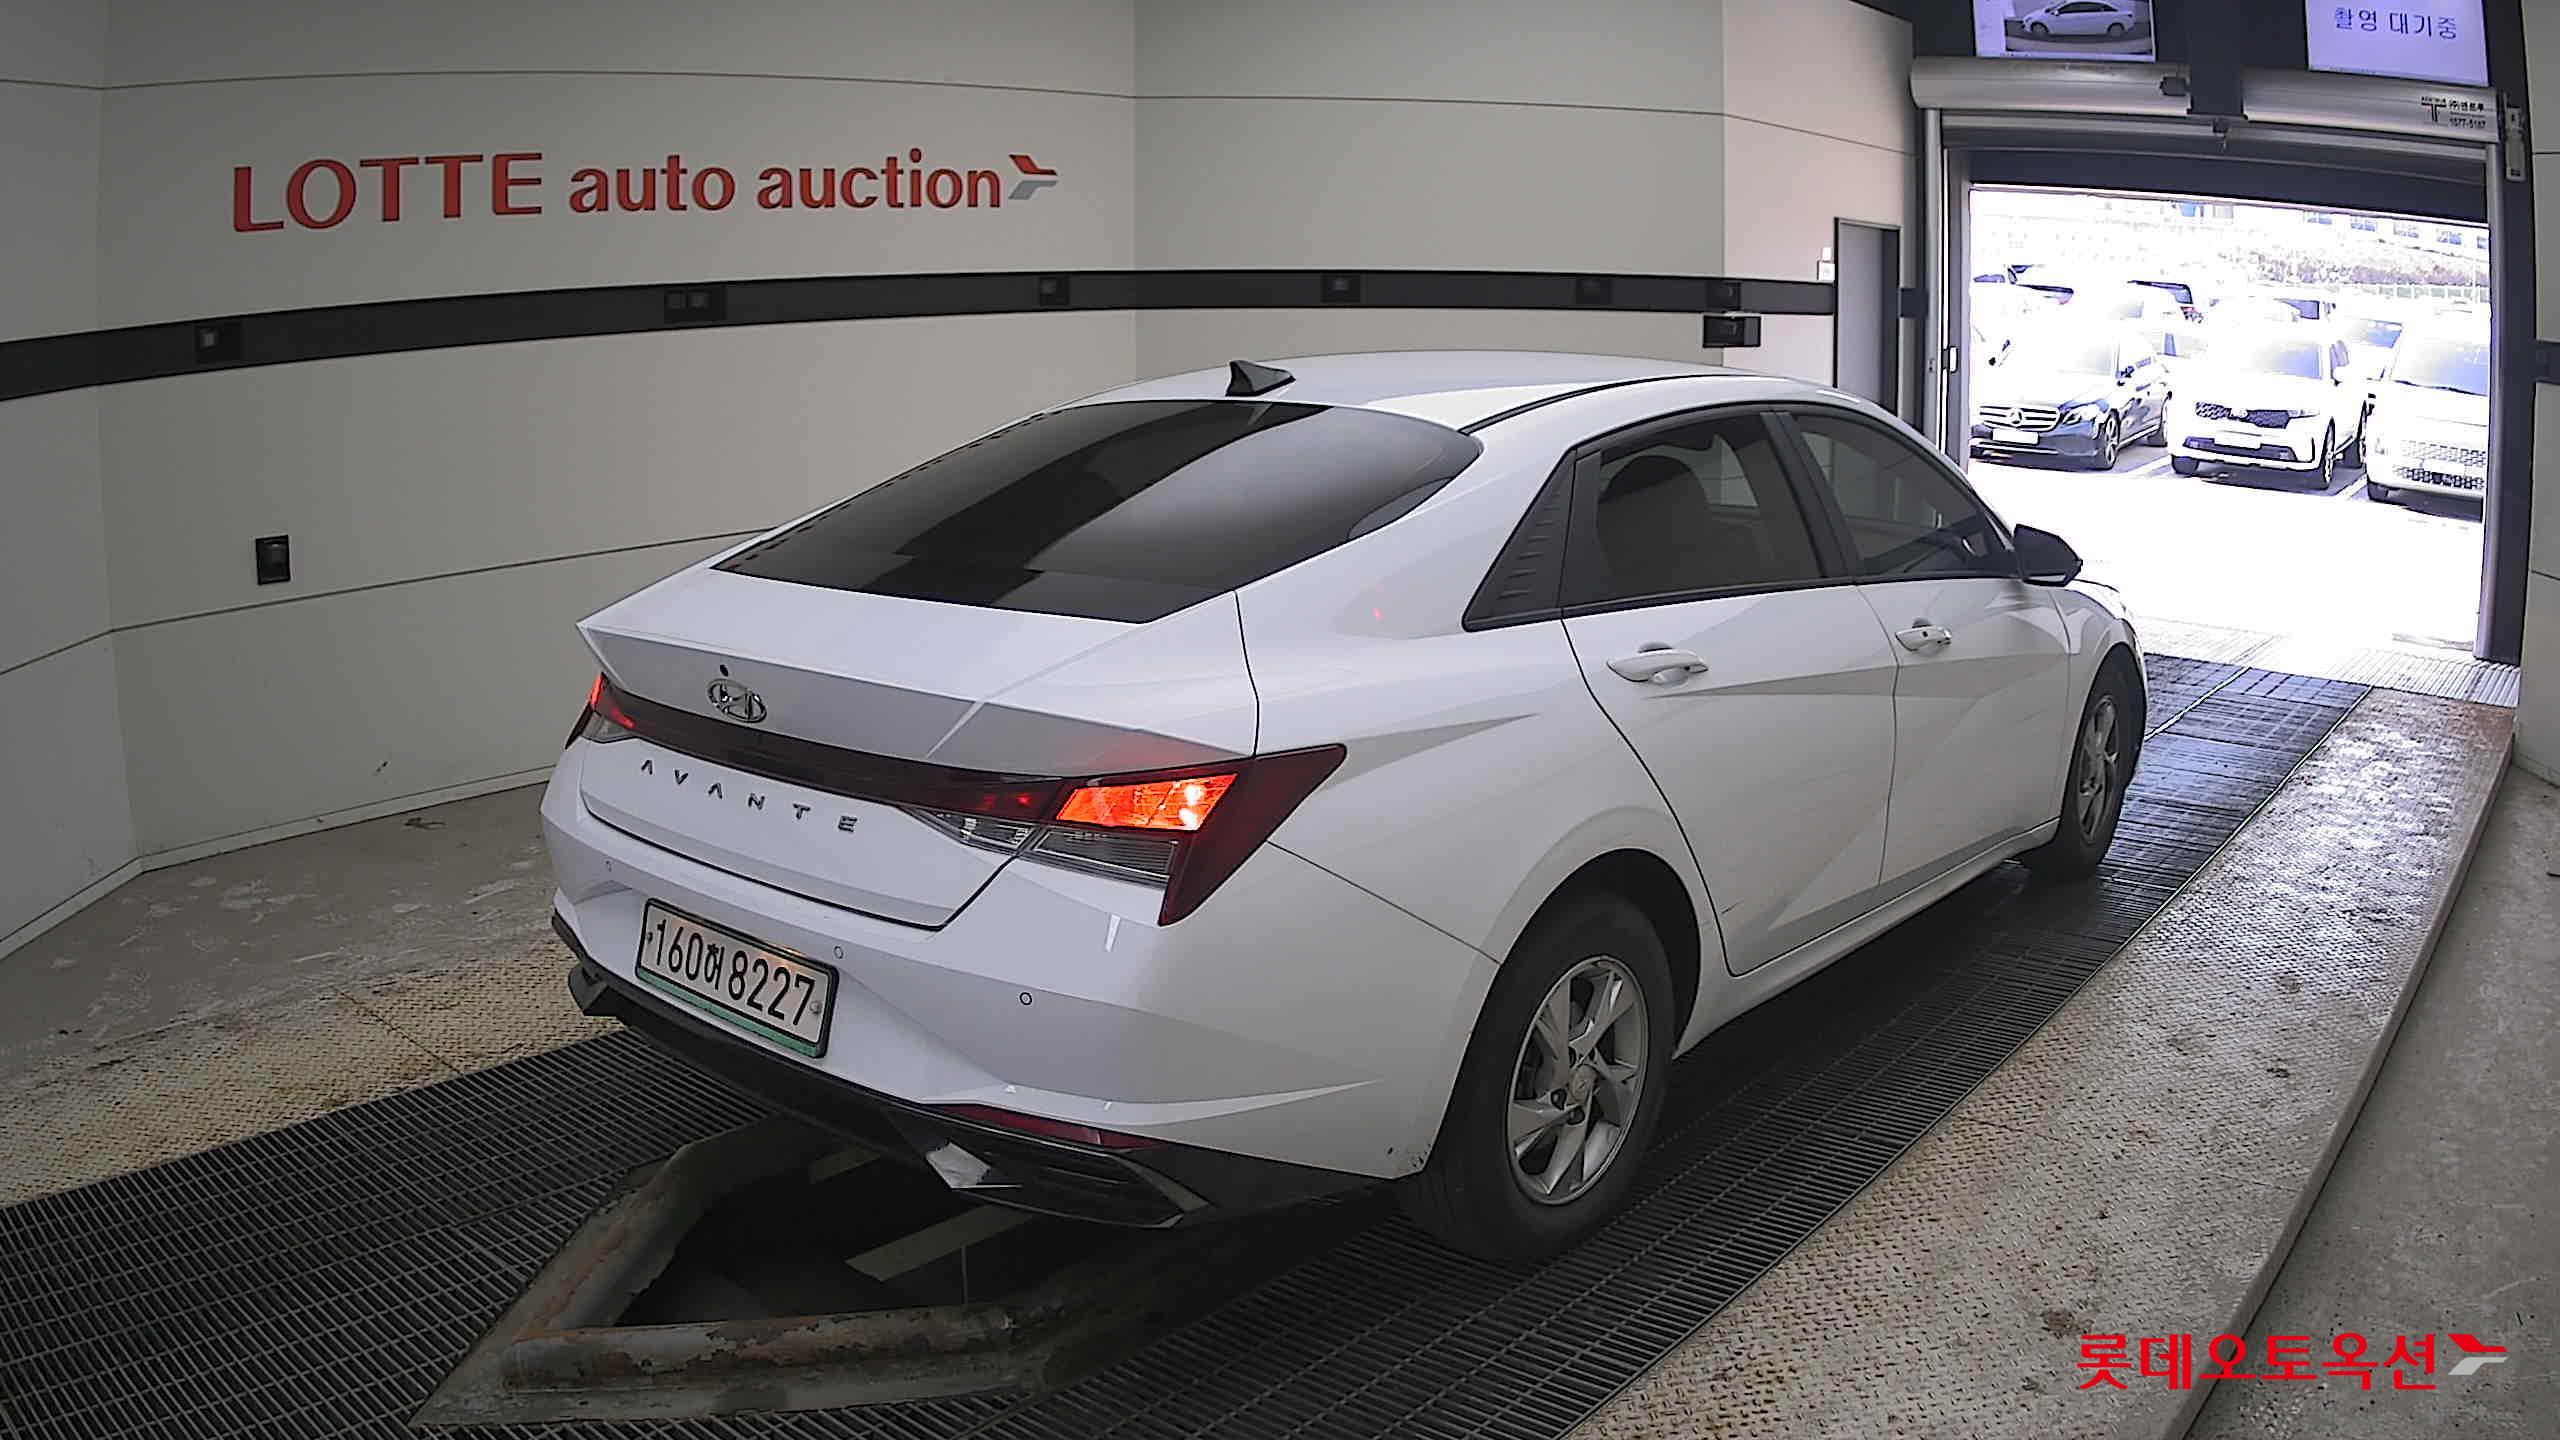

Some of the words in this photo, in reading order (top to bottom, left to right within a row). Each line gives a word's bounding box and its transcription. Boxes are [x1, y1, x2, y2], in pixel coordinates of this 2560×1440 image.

[233, 152, 543, 233] LOTTE
[568, 153, 735, 213] auto
[757, 147, 1001, 210] auction
[640, 759, 858, 833] AVANTE
[656, 919, 816, 1026] 160허8227
